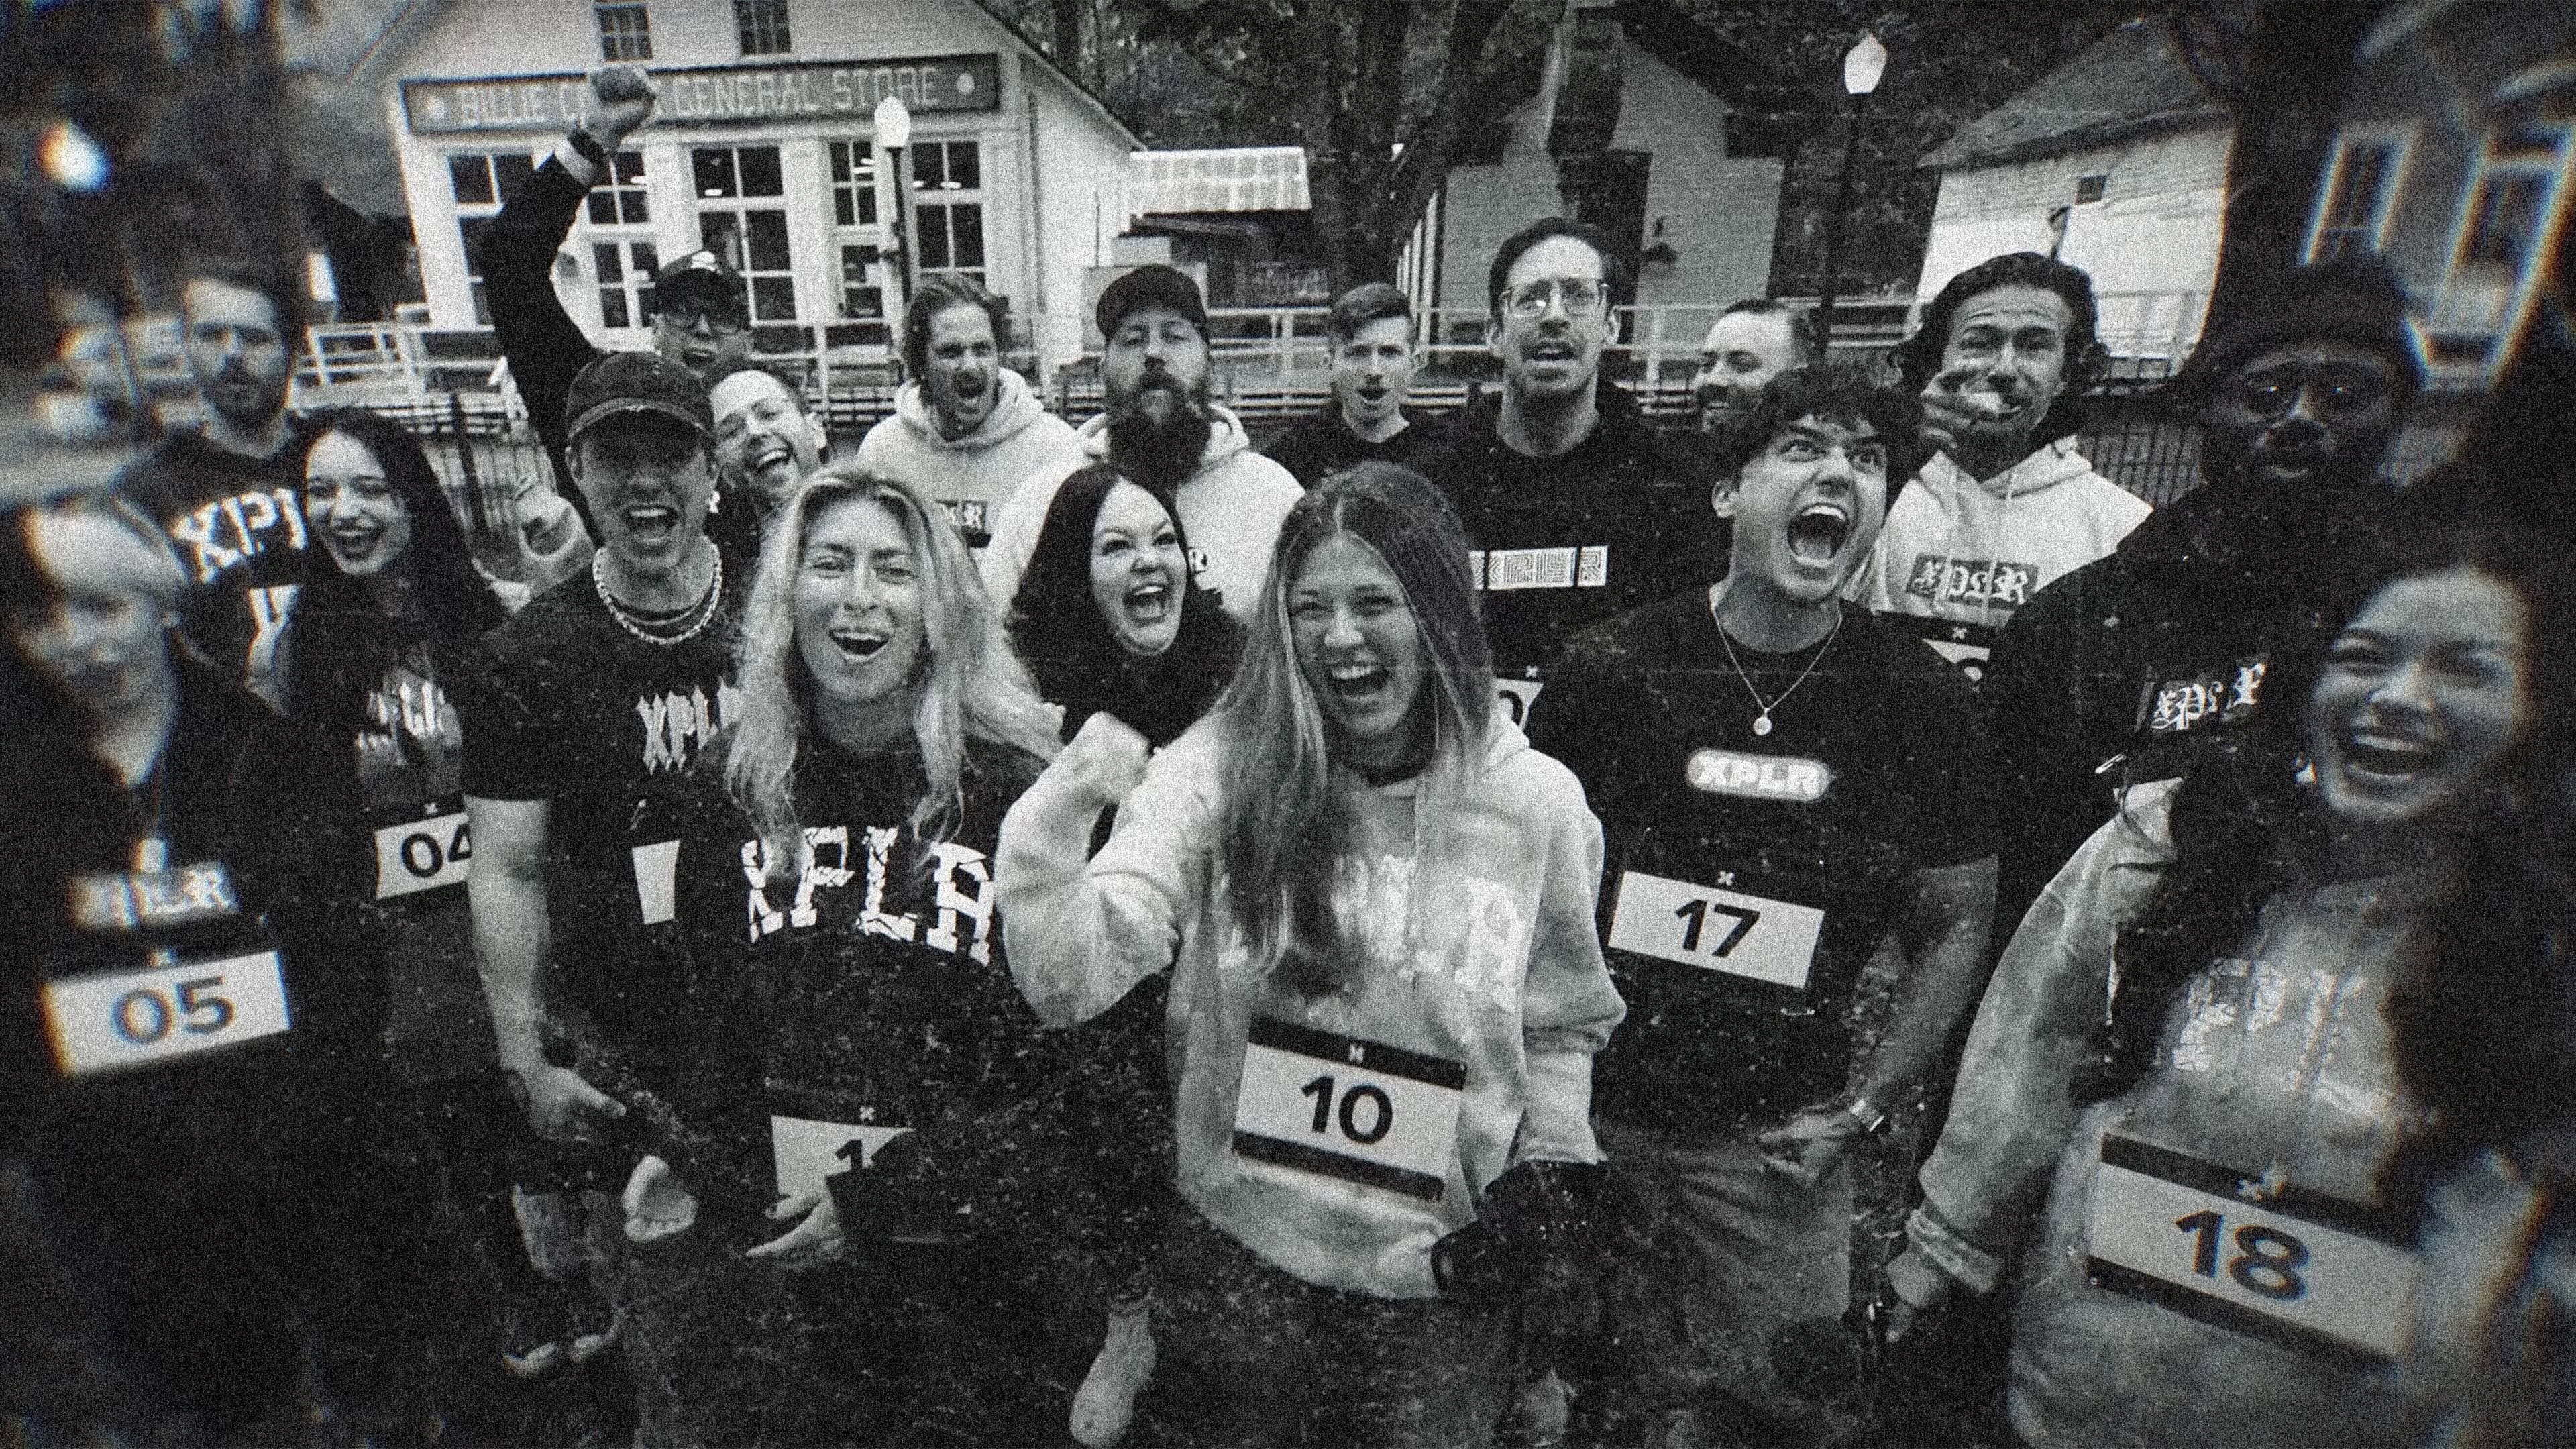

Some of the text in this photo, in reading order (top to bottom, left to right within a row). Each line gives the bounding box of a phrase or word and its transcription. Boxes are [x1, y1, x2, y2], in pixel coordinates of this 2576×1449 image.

[458, 85, 547, 126] BILLIE
[672, 69, 821, 116] GENERAL
[831, 66, 939, 110] STORE
[1694, 753, 1828, 794] XPLR
[1676, 899, 1761, 957] 17
[111, 975, 235, 1044] 05
[1301, 1075, 1393, 1144] 10
[2175, 1209, 2310, 1300] 18
